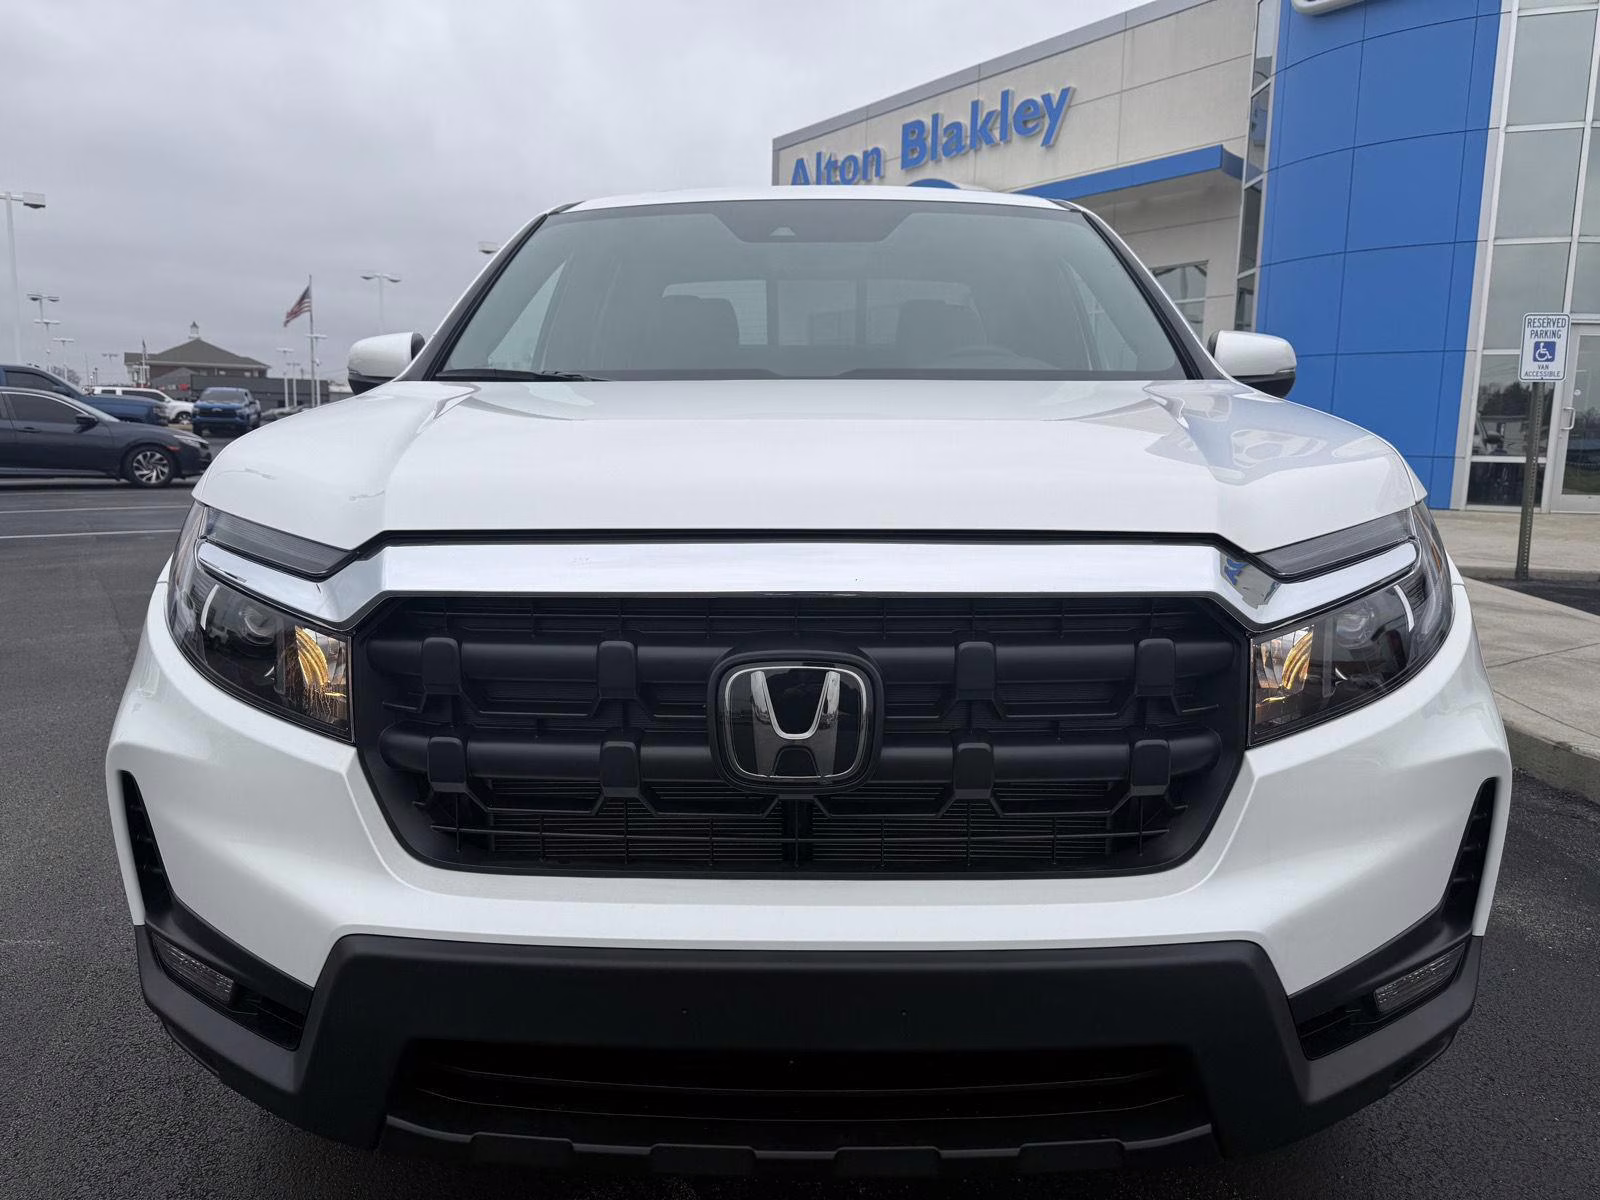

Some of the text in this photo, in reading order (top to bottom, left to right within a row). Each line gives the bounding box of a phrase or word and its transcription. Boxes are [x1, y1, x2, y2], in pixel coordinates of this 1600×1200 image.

[790, 86, 1077, 186] Alton Blakley
[1527, 317, 1567, 329] RESERVED
[1530, 329, 1562, 339] PARKING
